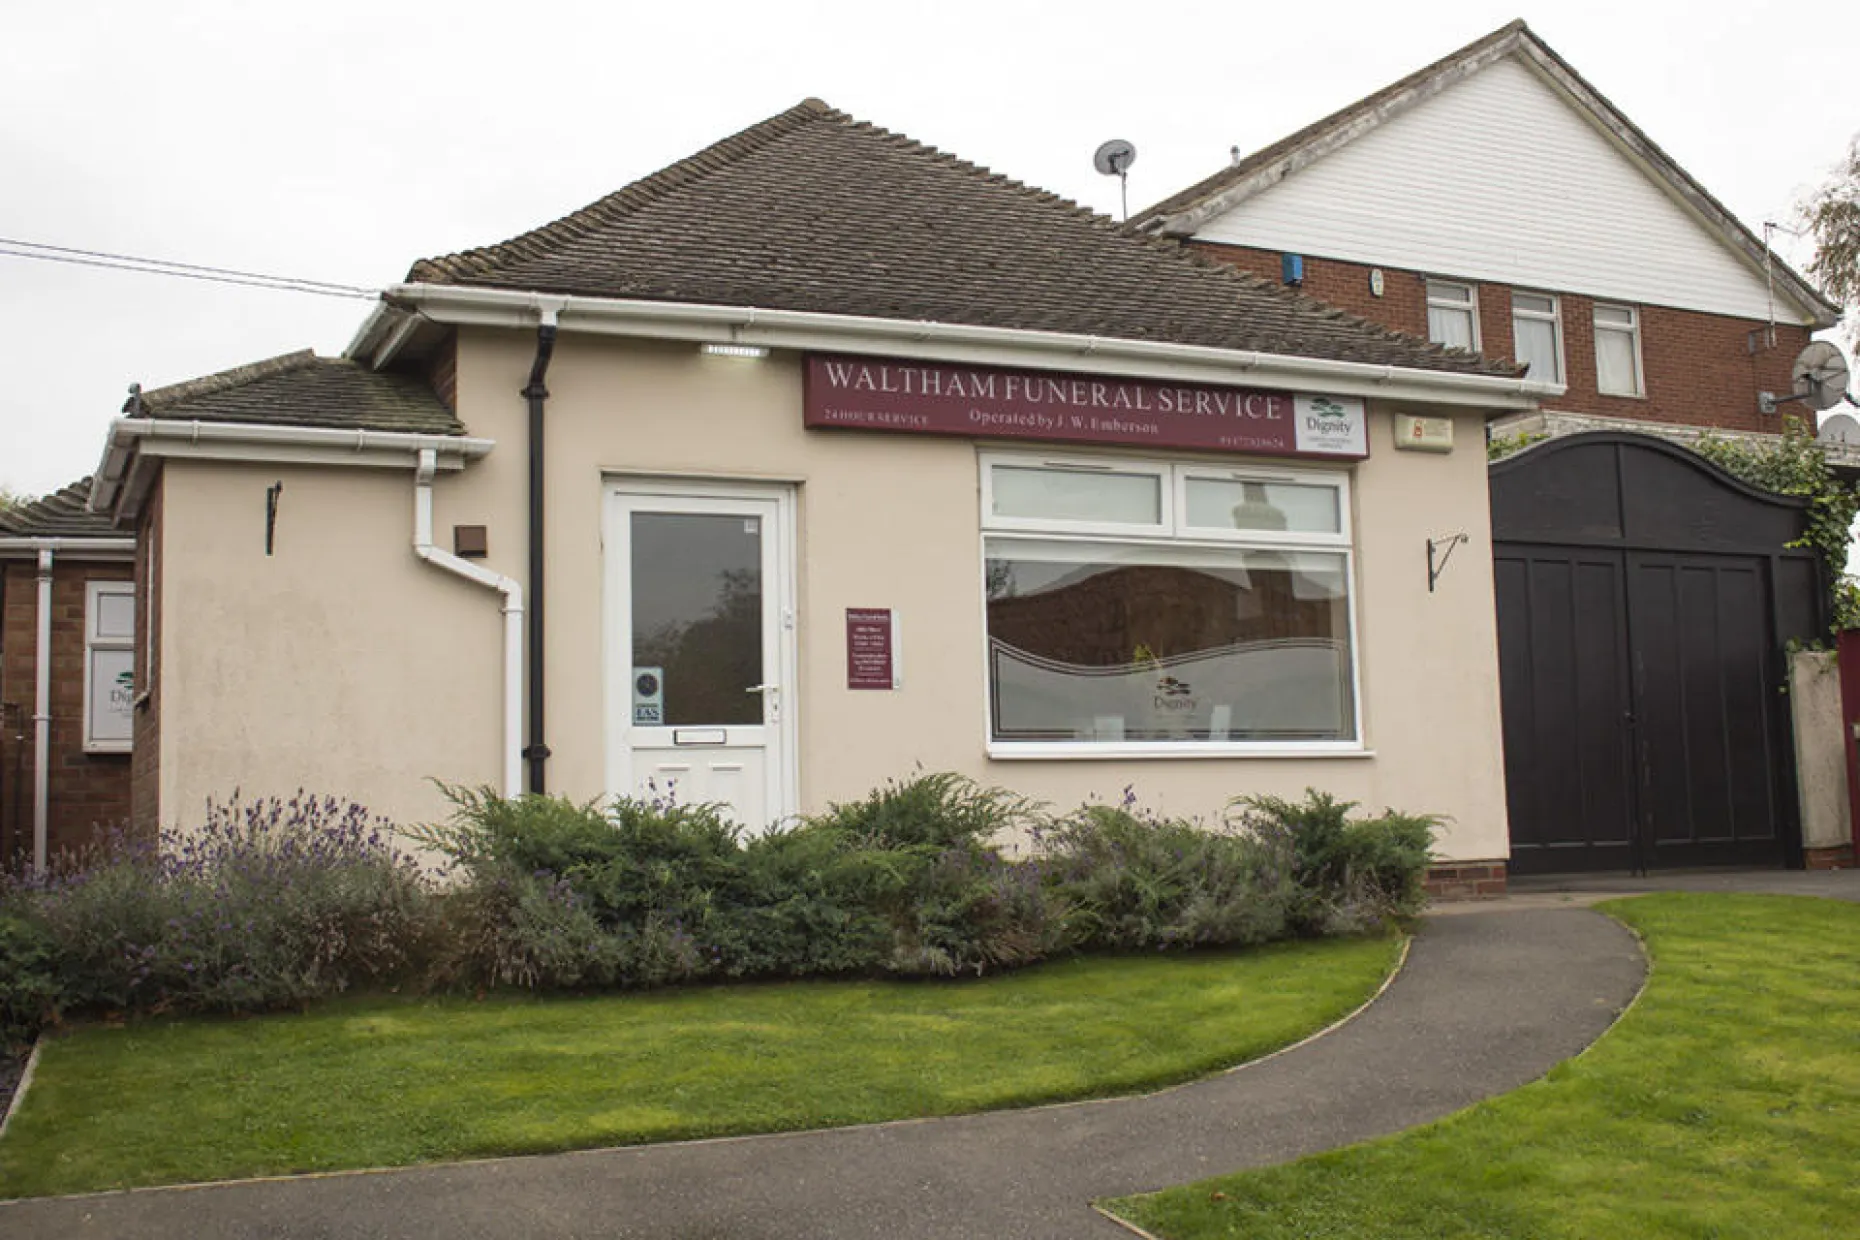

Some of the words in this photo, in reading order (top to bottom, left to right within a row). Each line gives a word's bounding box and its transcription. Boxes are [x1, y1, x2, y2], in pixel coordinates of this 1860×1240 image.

[824, 361, 996, 398] WALTHAM
[1004, 375, 1151, 410] FUNERAL
[1157, 387, 1282, 419] SERVICE
[877, 411, 928, 427] SERVICE
[969, 408, 1036, 427] Operated
[1037, 413, 1053, 431] by
[1307, 416, 1353, 437] Dignity
